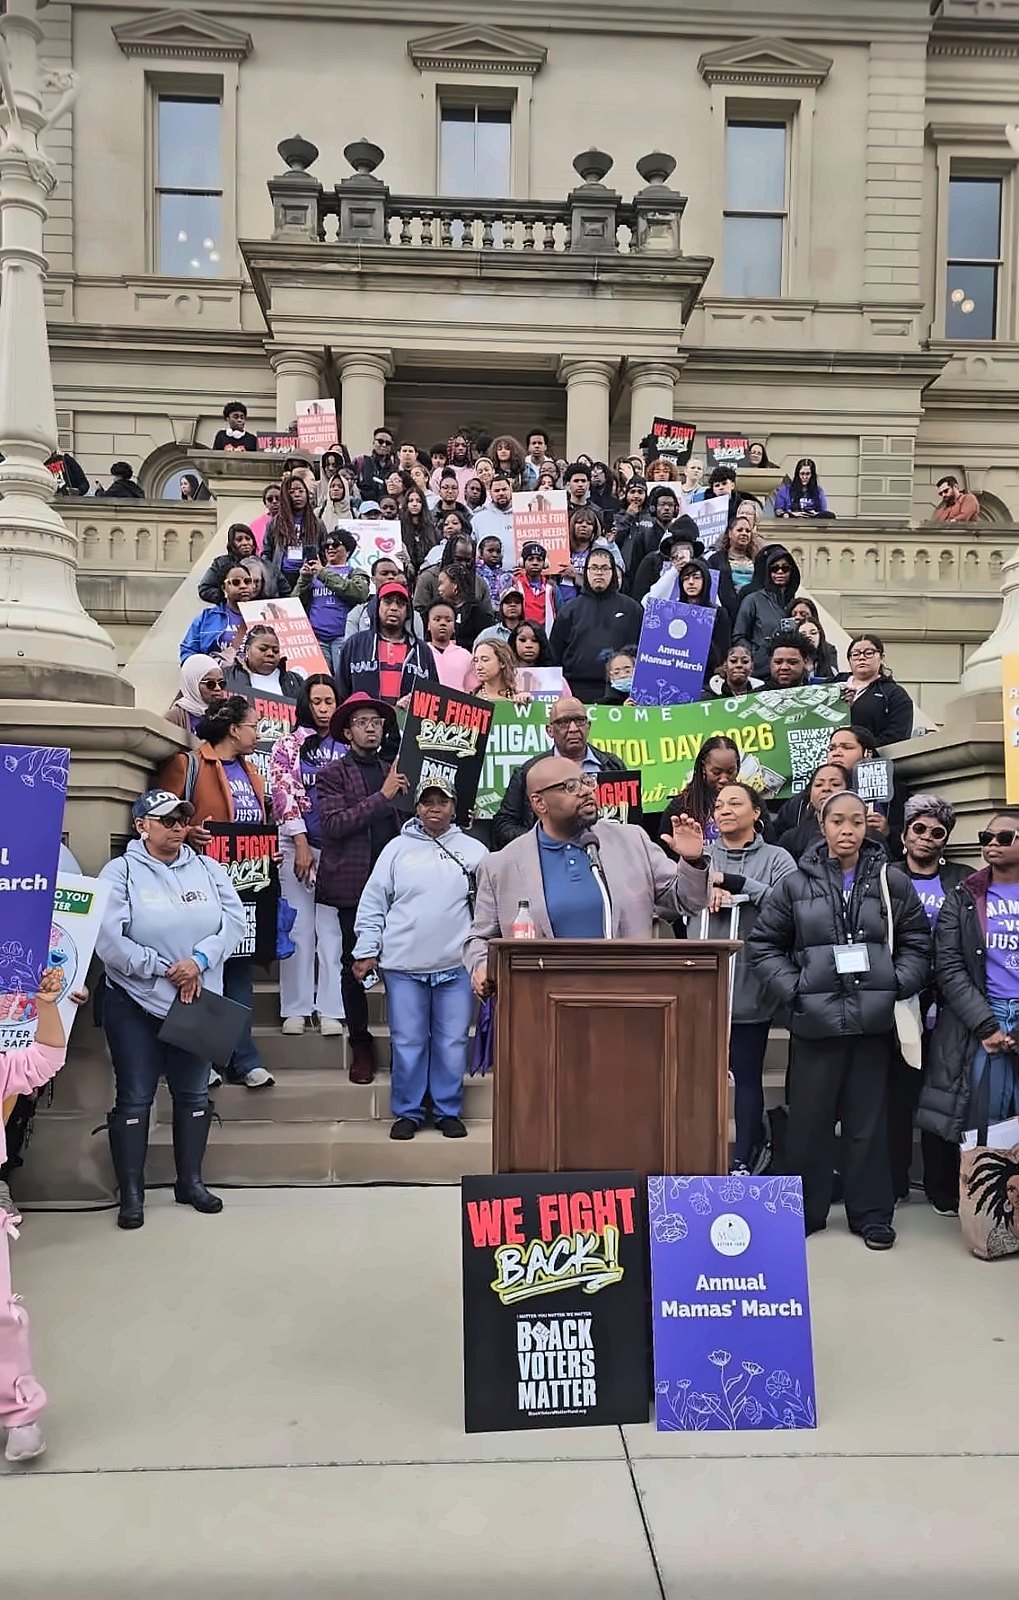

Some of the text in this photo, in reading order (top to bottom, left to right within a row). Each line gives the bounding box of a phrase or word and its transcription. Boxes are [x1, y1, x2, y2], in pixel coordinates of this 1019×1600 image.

[653, 423, 667, 437] WE
[258, 435, 274, 449] WE
[707, 438, 721, 449] WE
[515, 512, 567, 525] MAMAS FOR
[516, 526, 567, 539] BASIC NEEDS
[289, 620, 308, 631] FOR
[288, 635, 314, 647] NEEDS
[657, 644, 690, 658] Annual
[640, 653, 703, 672] Mamas' March
[254, 697, 298, 727] FIGHT
[413, 690, 491, 735] WE FIGHT
[513, 700, 739, 723] WECOME TO
[417, 718, 481, 752] BACK!
[659, 731, 705, 764] DAY
[858, 785, 888, 798] MATTER
[205, 834, 278, 863] WE FIGHT
[66, 892, 90, 904] YOU
[466, 1188, 636, 1248] WE FIGHT
[496, 1230, 619, 1288] BACK!
[696, 1273, 767, 1291] Annual
[661, 1299, 803, 1318] Mamas' March
[518, 1349, 596, 1380] VOTERS
[518, 1378, 597, 1410] MATTER
